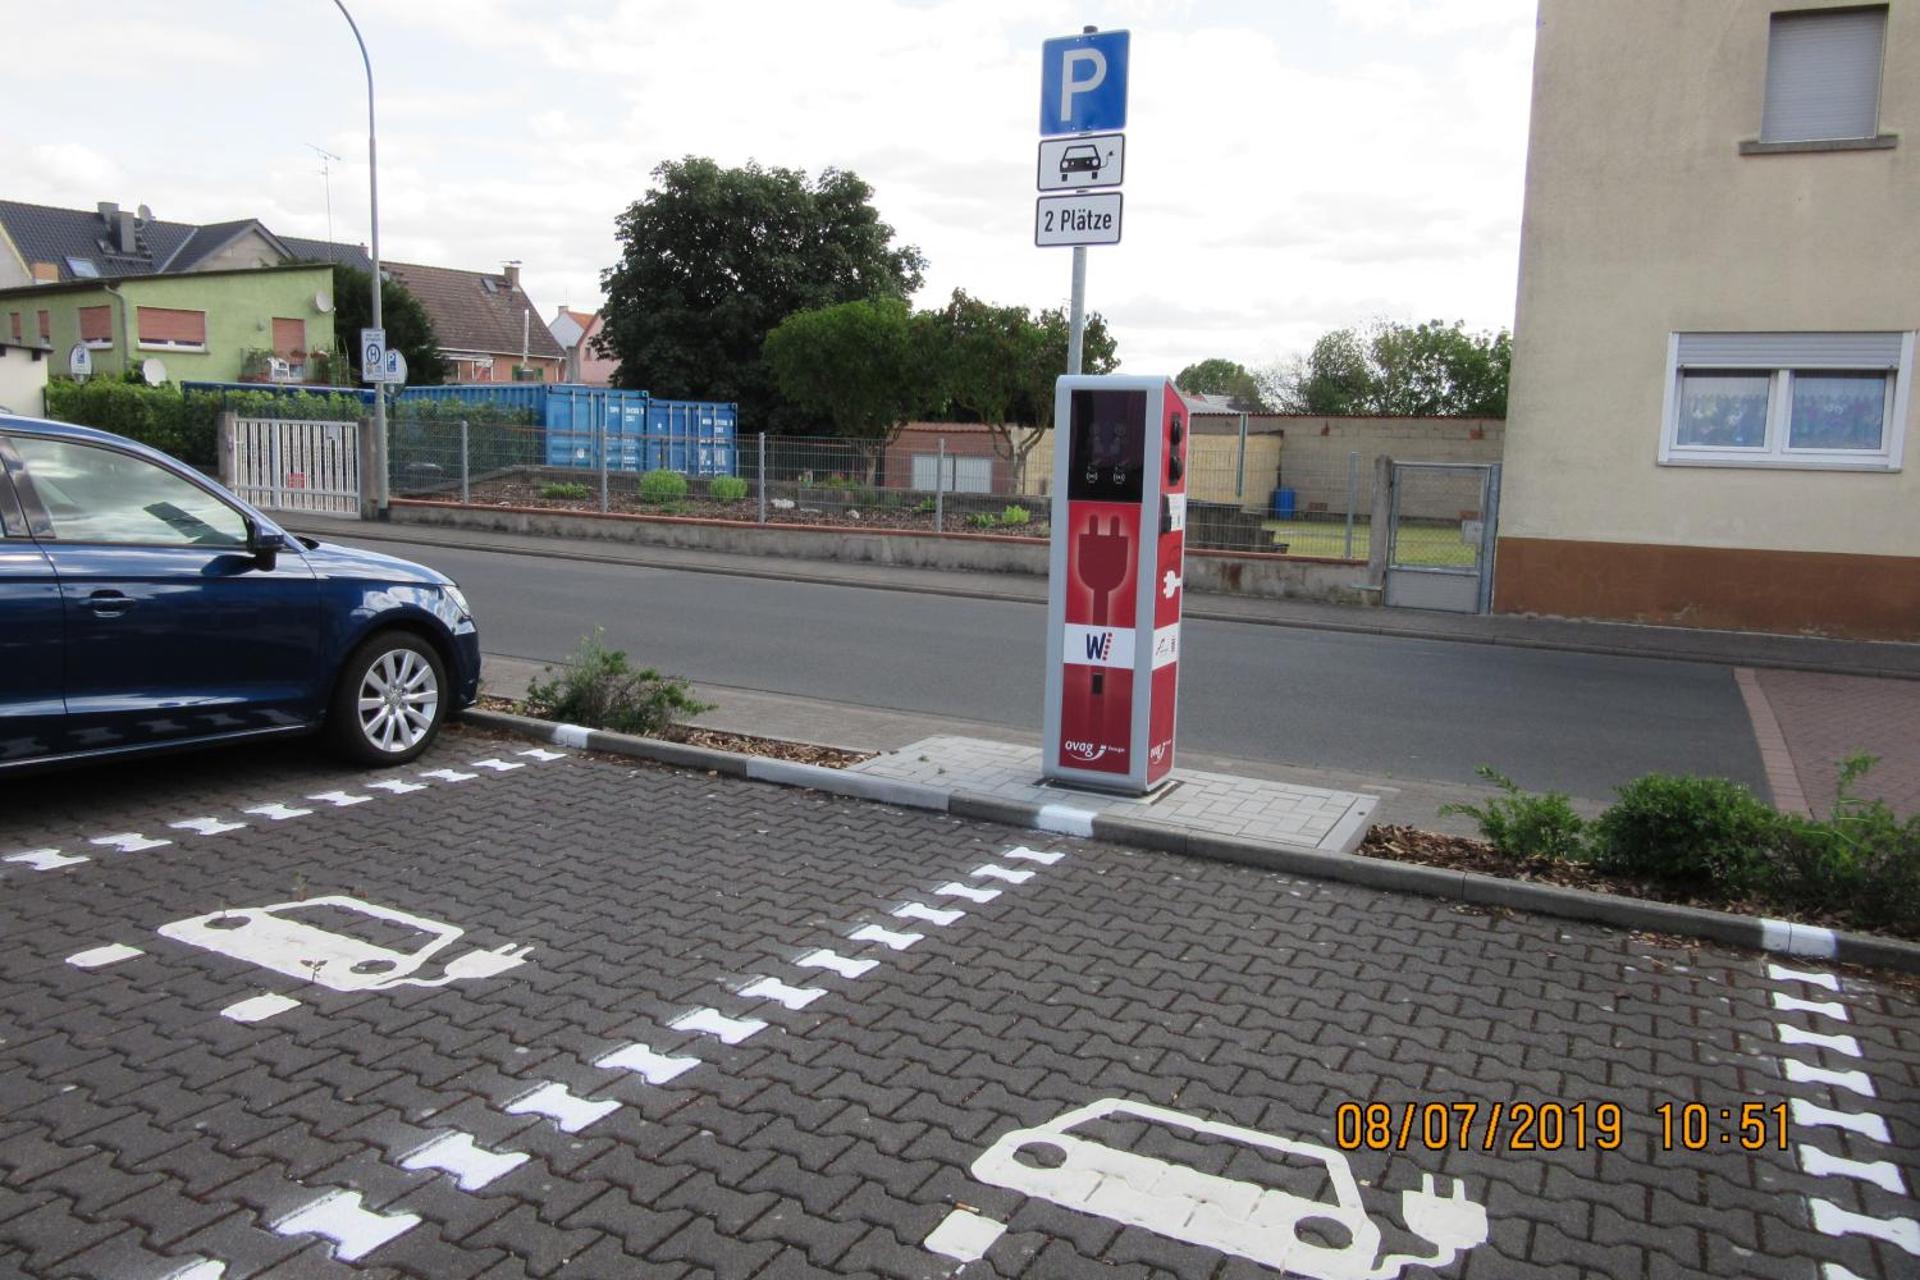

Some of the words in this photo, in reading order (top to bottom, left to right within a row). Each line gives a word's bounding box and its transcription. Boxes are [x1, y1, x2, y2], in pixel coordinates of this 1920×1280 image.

[1060, 47, 1107, 122] P
[1044, 210, 1054, 232] 2
[1060, 208, 1112, 232] Plätze
[1065, 740, 1094, 757] ovag
